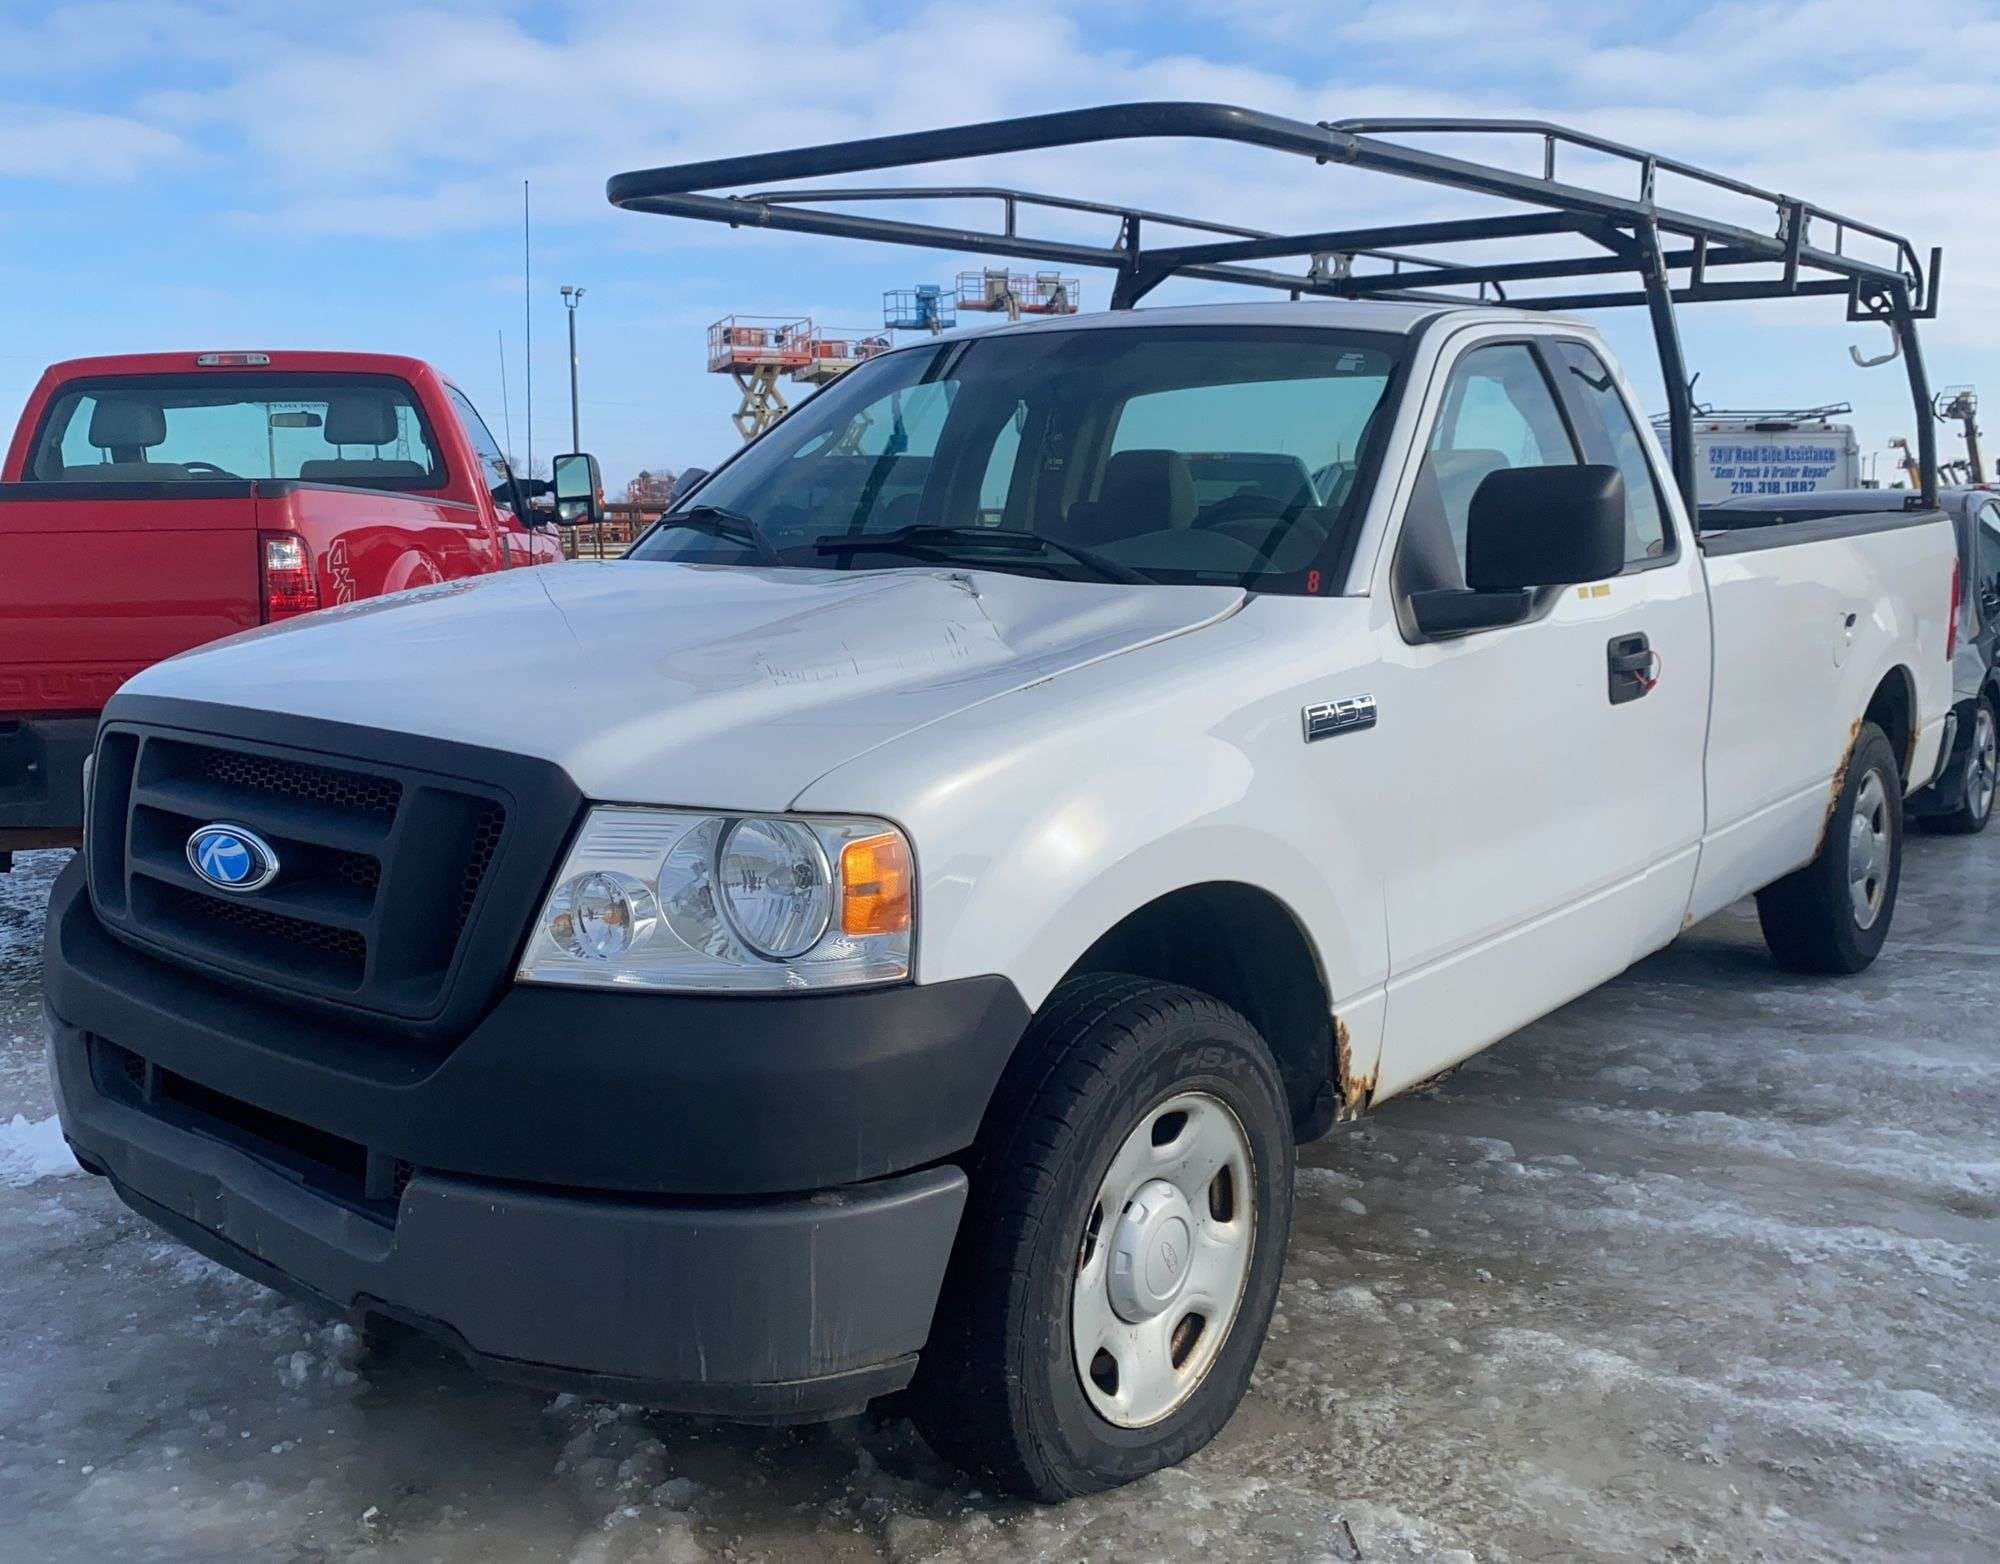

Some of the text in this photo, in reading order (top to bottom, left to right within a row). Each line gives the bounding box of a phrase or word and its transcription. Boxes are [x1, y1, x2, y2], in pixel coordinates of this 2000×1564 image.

[1735, 447, 1759, 463] Road
[1761, 446, 1782, 463] Side
[1784, 446, 1836, 463] Assistance
[1738, 466, 1760, 478] Truck
[1772, 466, 1800, 478] Trailer
[1307, 569, 1320, 593] 8
